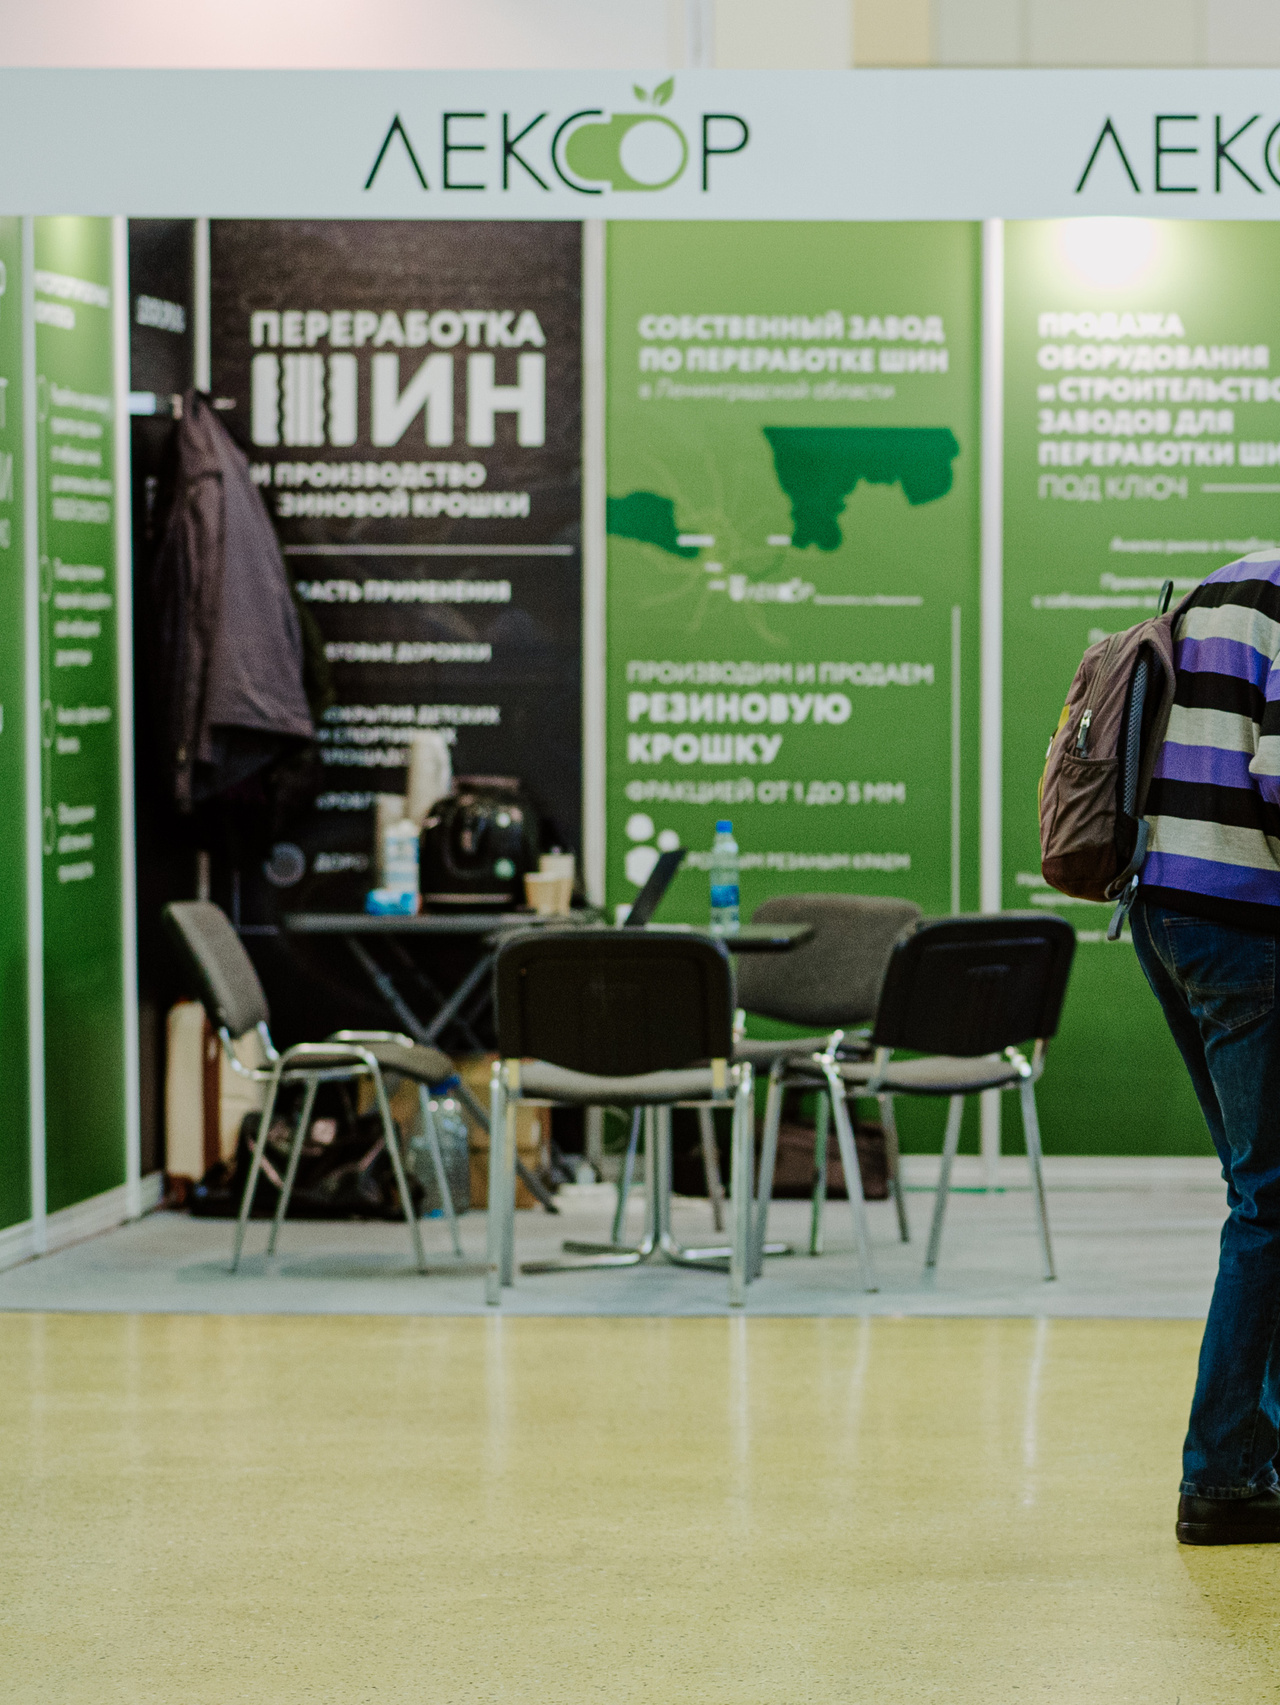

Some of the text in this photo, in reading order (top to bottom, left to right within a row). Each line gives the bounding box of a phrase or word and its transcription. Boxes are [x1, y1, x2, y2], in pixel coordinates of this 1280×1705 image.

[252, 309, 546, 348] ПЕРЕРАБОТКА
[638, 311, 945, 344] СОБСТВЕННЫЙ ЗАВОД
[1038, 312, 1184, 341] ПРОДАЖА
[639, 347, 949, 373] ПО ПЕРЕРАБОТКЕ ШИН
[1038, 345, 1270, 373] ОБОРУДОВАНИЯ
[252, 352, 546, 447] ШИН
[1038, 409, 1235, 437] ЗАВОДОВ ДЛЯ
[1038, 441, 1235, 467] ПЕРЕРАБОТКИ
[274, 461, 487, 488] ПРОИЗВОДСТВО
[1038, 474, 1189, 502] ПОД КЛЮЧ
[279, 489, 531, 518] ЗИНОВОЙ КРОШКИ
[364, 580, 511, 602] ПРИМЕНЕНИЯ
[626, 661, 935, 687] ПРОИЗВОДИМ И ПРОДАЕМ
[626, 691, 852, 725] РЕЗИНОВУЮ
[626, 732, 783, 764] КРОШКУ
[625, 777, 907, 805] ФРАКЦИЕЙ ОТ 1 ДО 5 ММ
